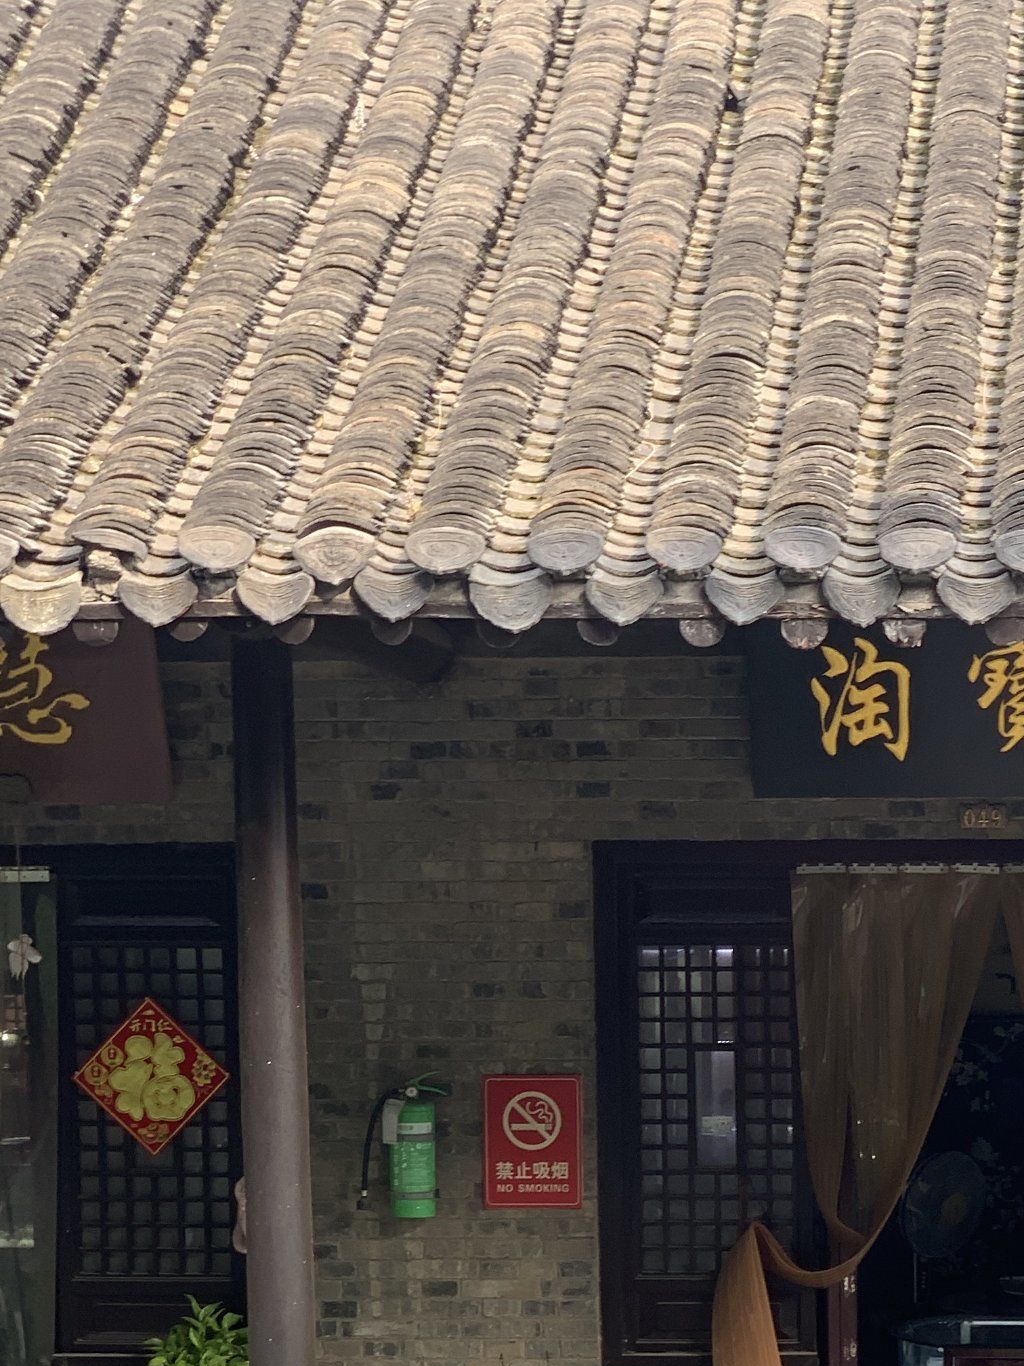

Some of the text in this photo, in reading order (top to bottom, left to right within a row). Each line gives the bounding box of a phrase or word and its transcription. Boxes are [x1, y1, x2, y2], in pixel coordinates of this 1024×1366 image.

[962, 808, 1002, 829] 049
[495, 1160, 570, 1181] 禁止吸烟
[496, 1183, 571, 1194] NO SMOKING
